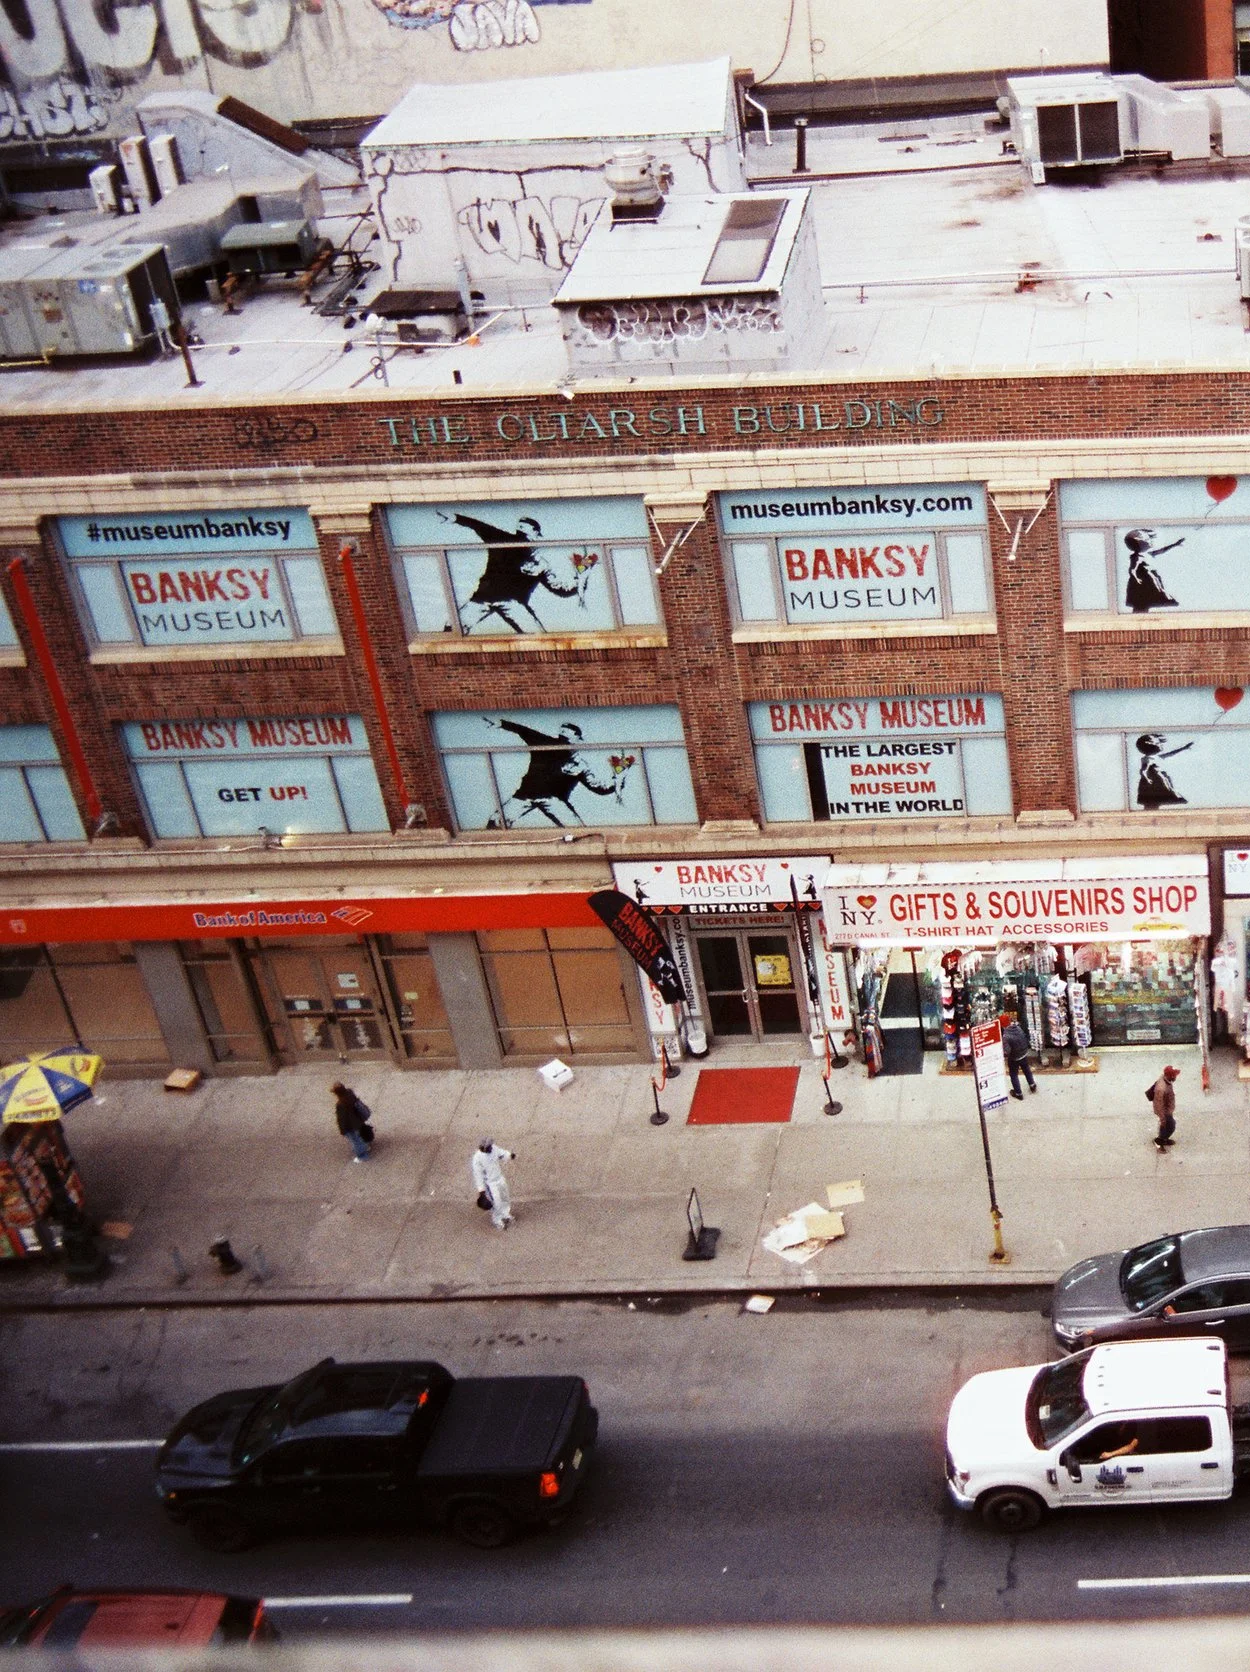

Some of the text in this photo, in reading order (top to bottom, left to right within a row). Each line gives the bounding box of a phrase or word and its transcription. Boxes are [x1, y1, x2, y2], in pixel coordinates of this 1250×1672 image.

[378, 397, 945, 446] THE OLTARSH BUILDING
[730, 494, 973, 520] museumbanksy.com
[87, 516, 291, 542] #museumbanksy
[784, 544, 930, 582] BANKSY
[130, 568, 269, 604] BANKSY
[790, 586, 937, 611] MUSEUM
[142, 609, 287, 634] MUSEUM
[769, 698, 986, 733] BANKSY MUSEUM
[140, 717, 352, 751] BANKSY MUSEUM
[821, 742, 957, 758] THE LARGEST
[850, 762, 932, 777] BANKSY
[218, 786, 308, 802] GET UP!
[850, 781, 936, 795] MUSEUM
[830, 798, 964, 815] IN THE WORLD
[677, 863, 768, 885] BANKSY
[680, 884, 772, 899] MUSEUM
[689, 902, 769, 914] ENTRANCE
[889, 884, 1198, 922] GIFTS & SOUVENIRS SHOP
[193, 909, 327, 928] Bank of America
[618, 902, 664, 957] BANKSY
[696, 915, 785, 926] TICKETS HERE!
[1002, 921, 1109, 936] ACCESSORIES
[904, 925, 994, 937] T-SHIRT HAT
